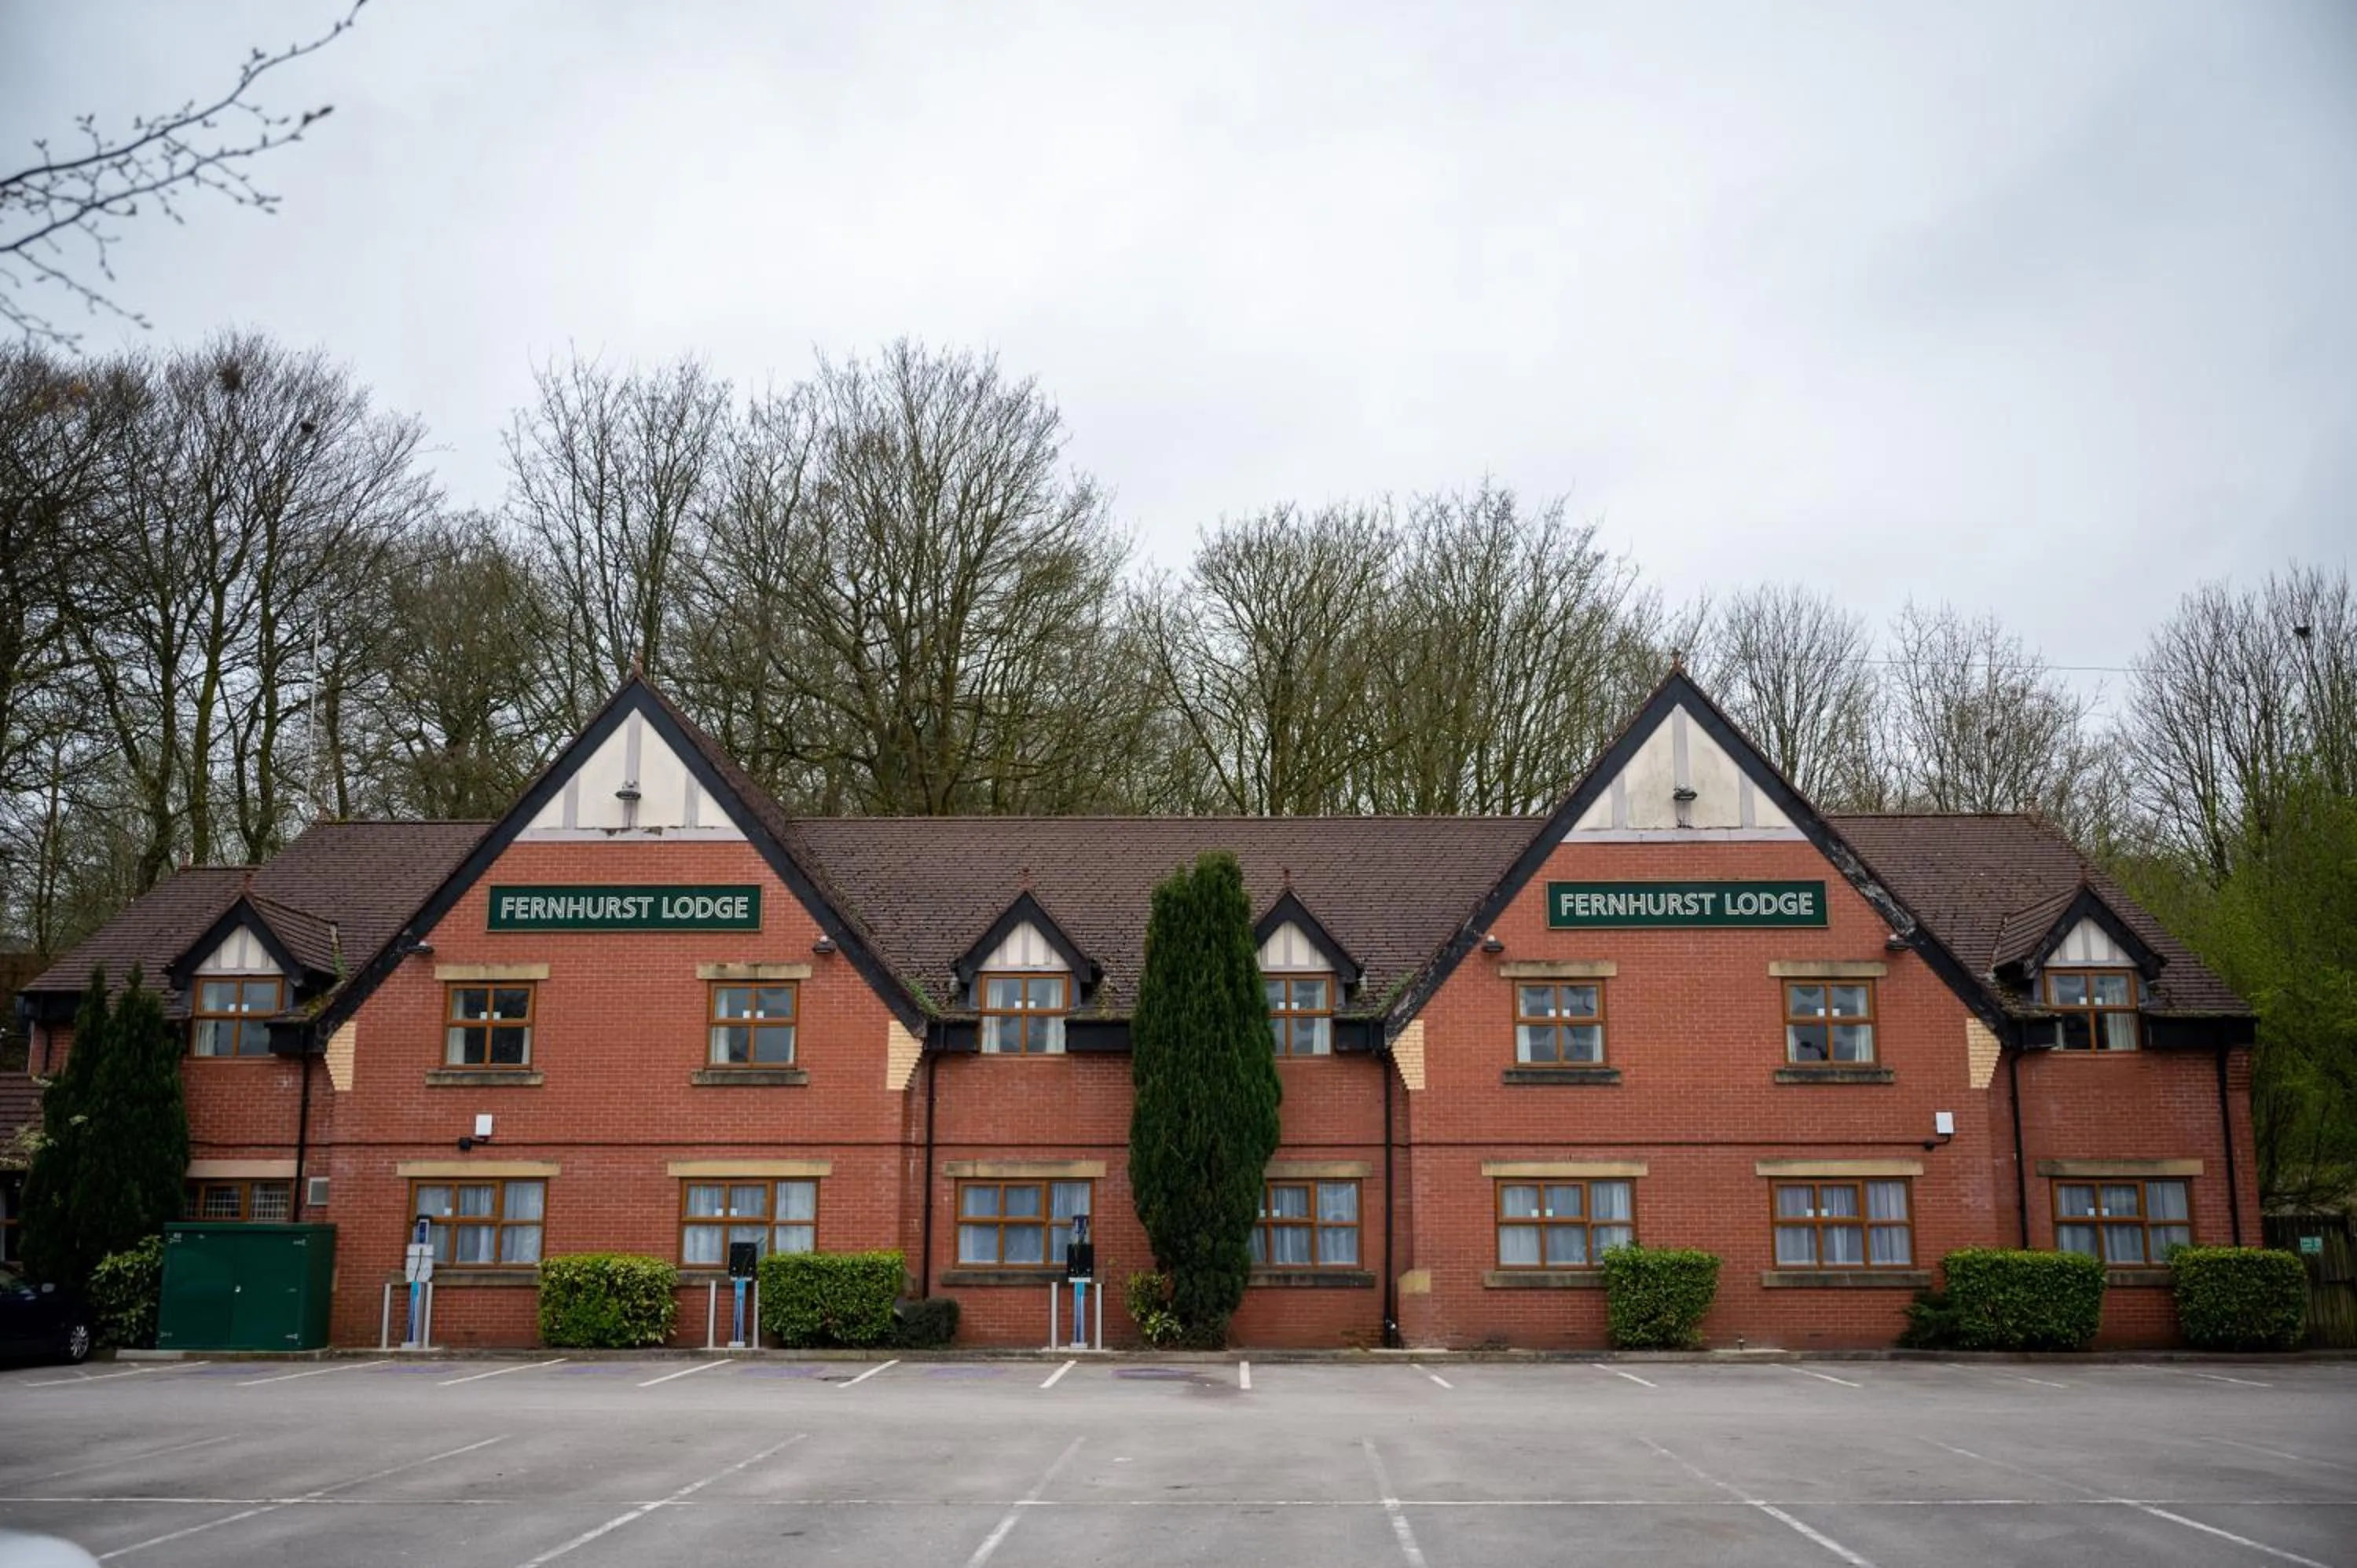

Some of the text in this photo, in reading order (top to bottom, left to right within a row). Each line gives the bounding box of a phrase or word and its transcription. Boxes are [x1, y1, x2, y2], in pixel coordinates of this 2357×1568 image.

[500, 896, 749, 919] FERNHURST LODGE
[1560, 892, 1814, 916] FERNHURST LODGE
